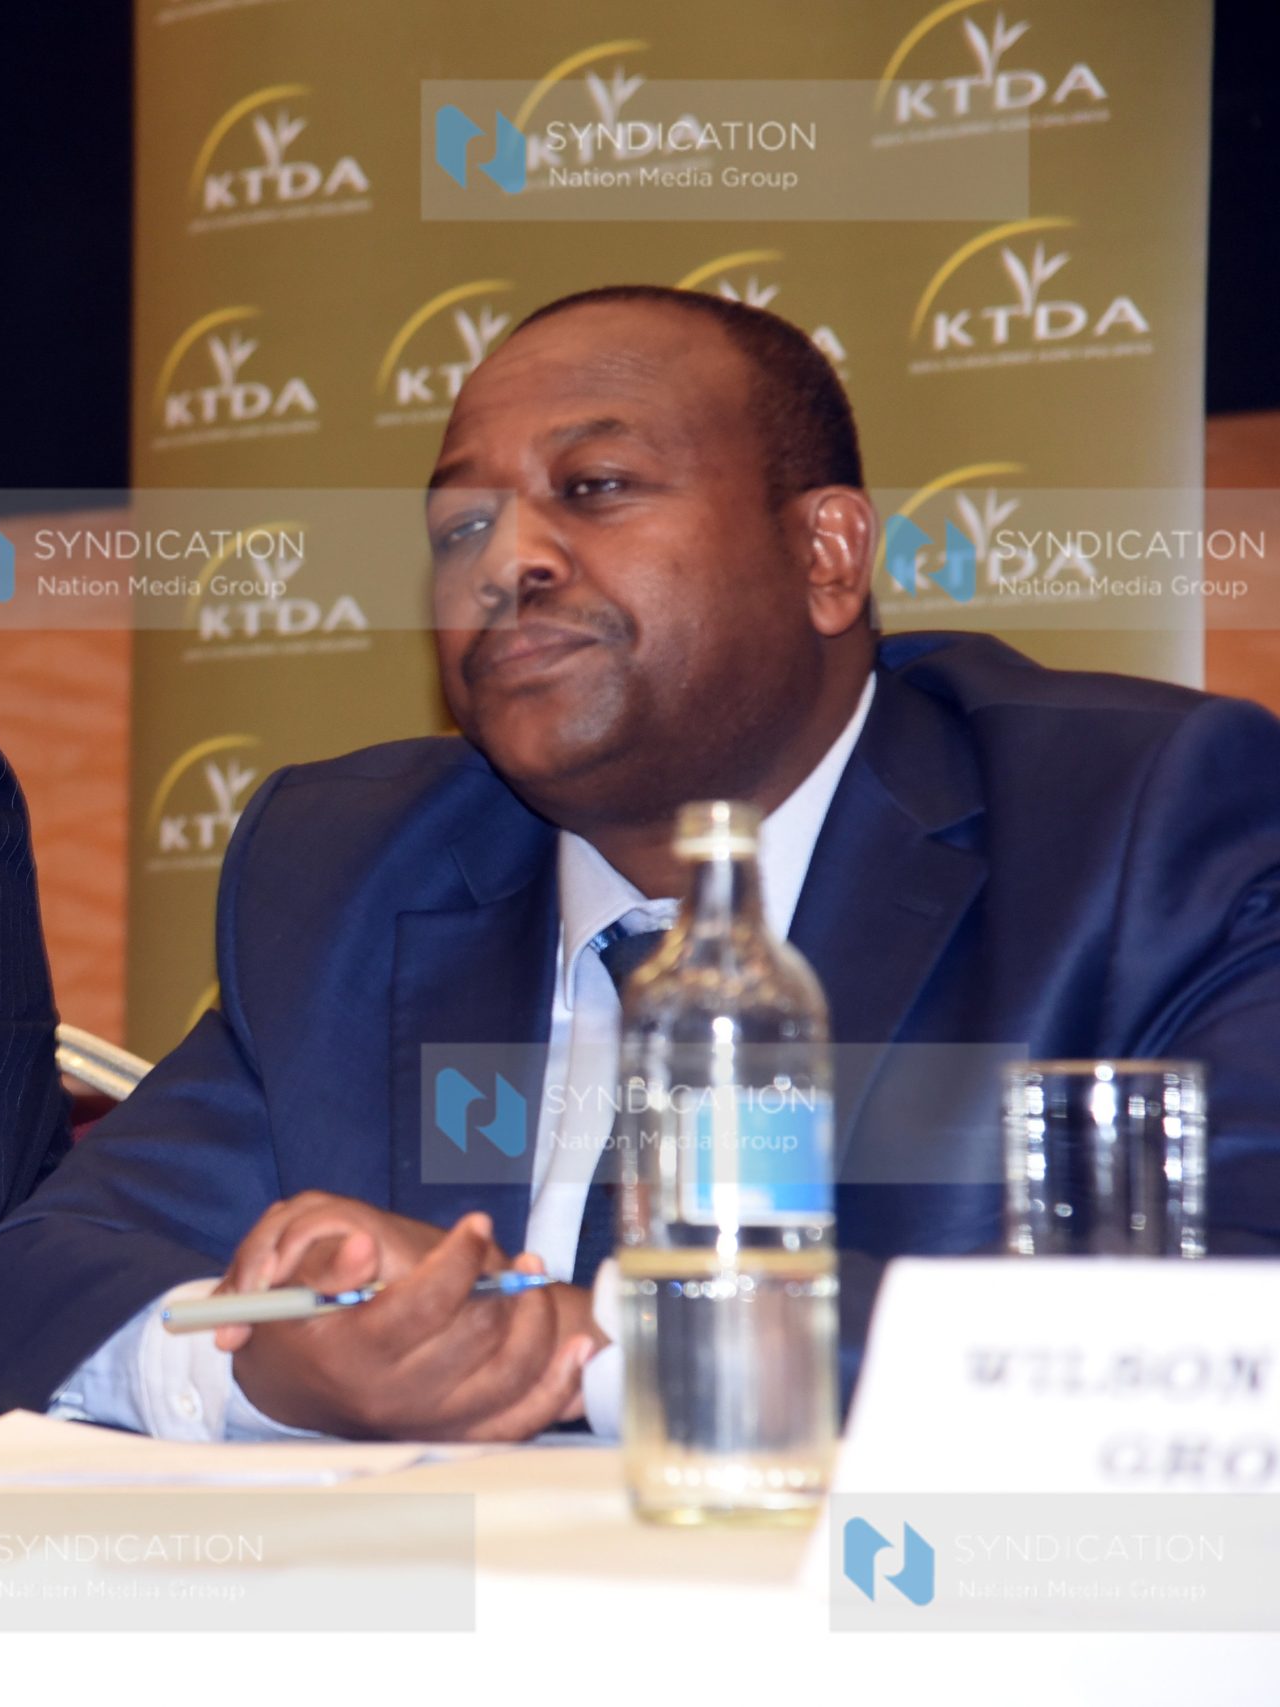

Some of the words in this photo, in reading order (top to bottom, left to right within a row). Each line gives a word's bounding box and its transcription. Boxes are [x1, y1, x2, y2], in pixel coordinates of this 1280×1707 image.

[895, 63, 1108, 124] KTDA
[526, 112, 712, 171] KTDA
[204, 157, 370, 210] KTDA
[932, 296, 1150, 351] KTDA
[164, 377, 318, 428] KTDA
[396, 362, 478, 405] KT
[891, 542, 1098, 593] KTDA
[199, 596, 370, 641] KTDA
[159, 812, 242, 852] KT
